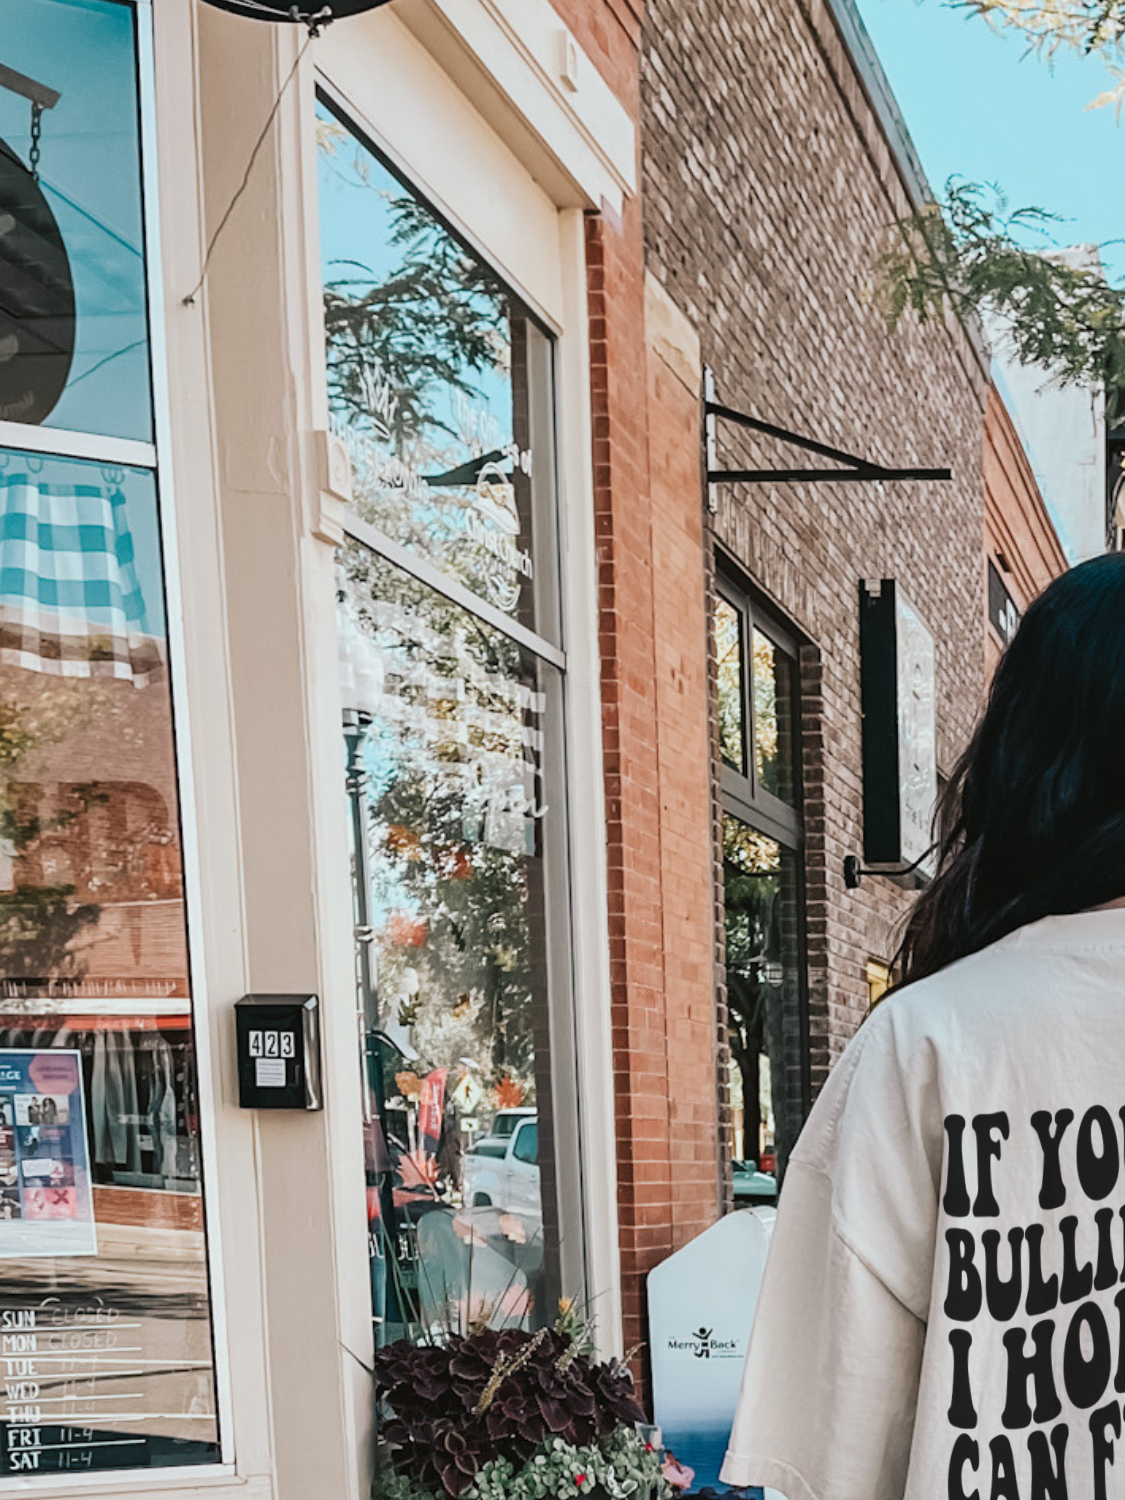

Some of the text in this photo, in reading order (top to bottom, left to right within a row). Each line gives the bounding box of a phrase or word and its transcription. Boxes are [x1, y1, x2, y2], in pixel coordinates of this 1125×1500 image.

[251, 1032, 293, 1056] 423
[942, 1110, 1010, 1218] IF
[2, 1307, 120, 1328] SUN CLOSED
[2, 1330, 118, 1352] MON CLOSED
[667, 1338, 737, 1351] Merry Back
[6, 1358, 39, 1376] TUE
[946, 1328, 978, 1430] I
[5, 1381, 40, 1400] WED
[6, 1404, 41, 1424] THU
[7, 1427, 94, 1448] FRI 11-4
[9, 1450, 93, 1471] SAT 11-4
